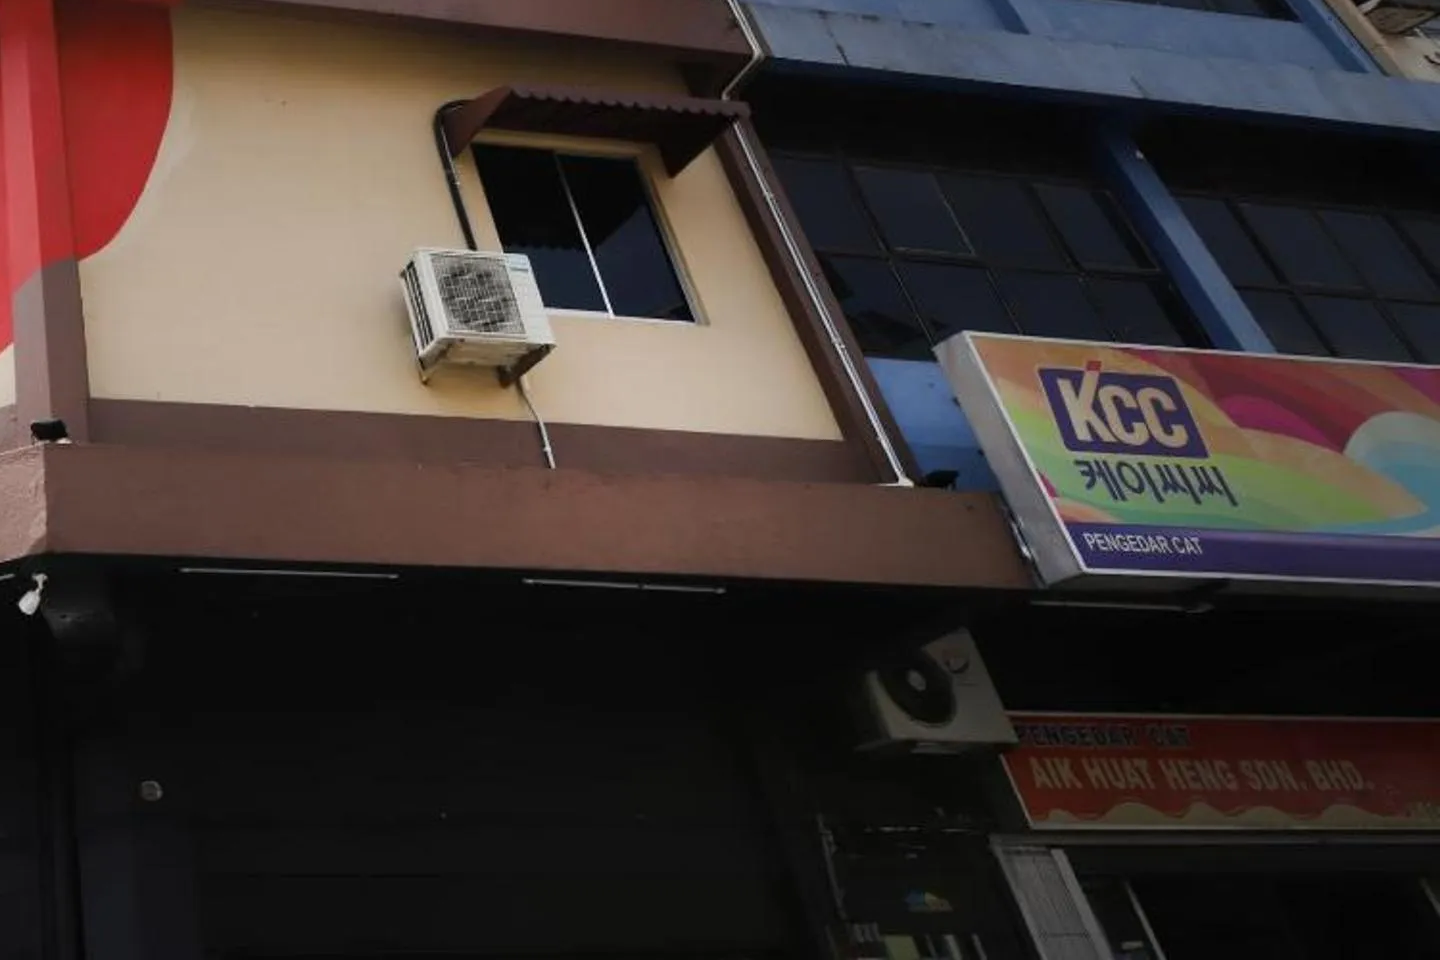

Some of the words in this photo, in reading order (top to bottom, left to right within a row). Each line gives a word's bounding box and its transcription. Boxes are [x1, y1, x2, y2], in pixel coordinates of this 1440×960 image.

[1056, 360, 1188, 449] KCC
[1082, 532, 1172, 554] PENGEDAR
[1172, 536, 1204, 555] CAT
[1028, 755, 1083, 790] AIK
[1082, 756, 1155, 791] HUAT
[1158, 758, 1239, 791] HENG
[1239, 759, 1309, 792] SDN.
[1307, 759, 1376, 792] BHD.
